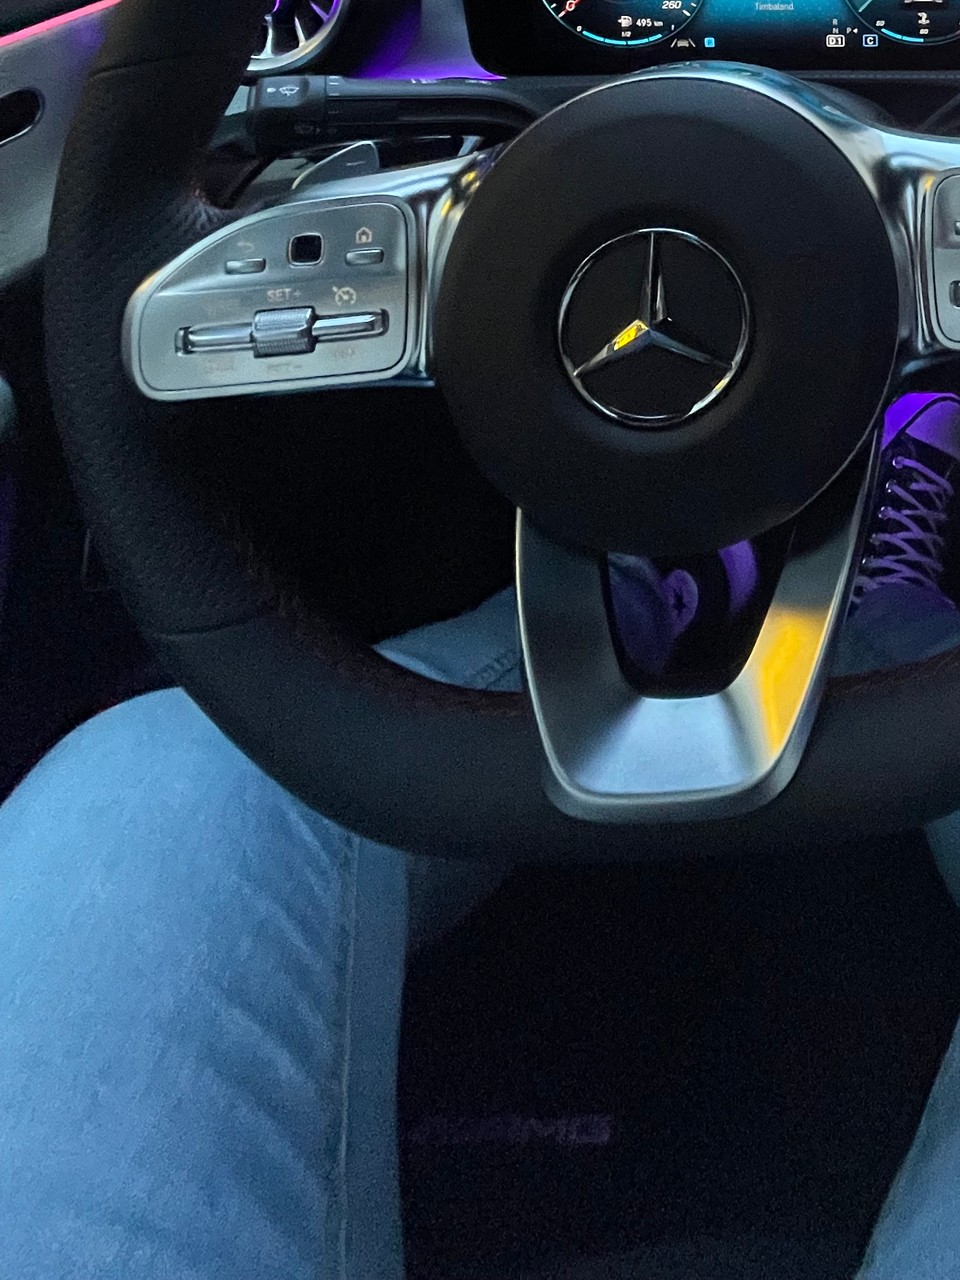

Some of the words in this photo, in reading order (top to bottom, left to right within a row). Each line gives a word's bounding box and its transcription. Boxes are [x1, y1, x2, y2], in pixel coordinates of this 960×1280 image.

[662, 0, 682, 9] 260
[755, 2, 794, 11] Timbaland
[635, 18, 651, 27] 495
[866, 36, 874, 44] C
